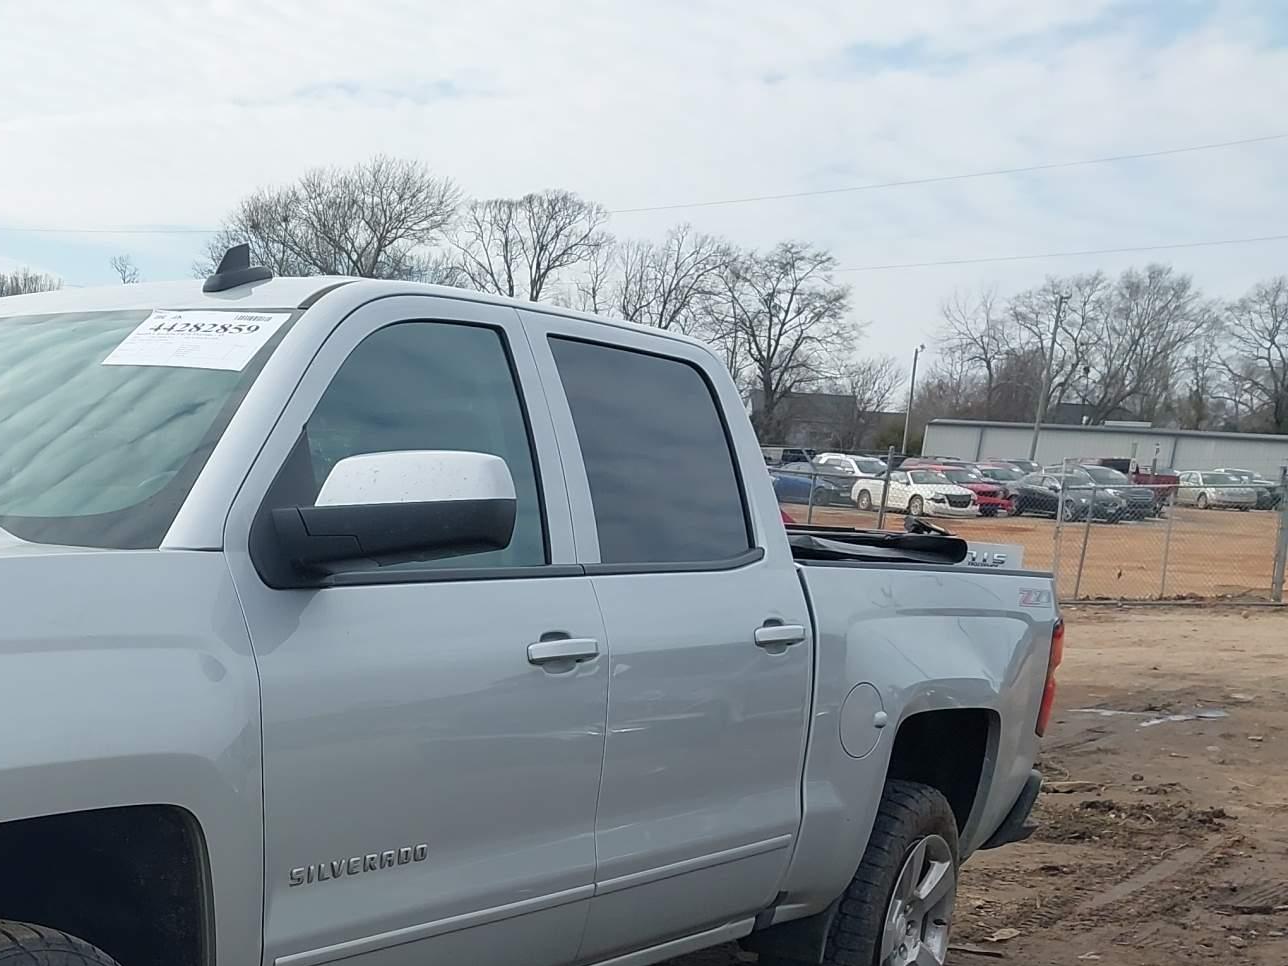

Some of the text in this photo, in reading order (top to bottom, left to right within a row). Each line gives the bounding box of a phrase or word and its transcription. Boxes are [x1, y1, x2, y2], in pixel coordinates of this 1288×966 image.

[149, 321, 260, 335] 44282859
[1019, 588, 1051, 608] Z71
[289, 843, 429, 887] SILVERADO
